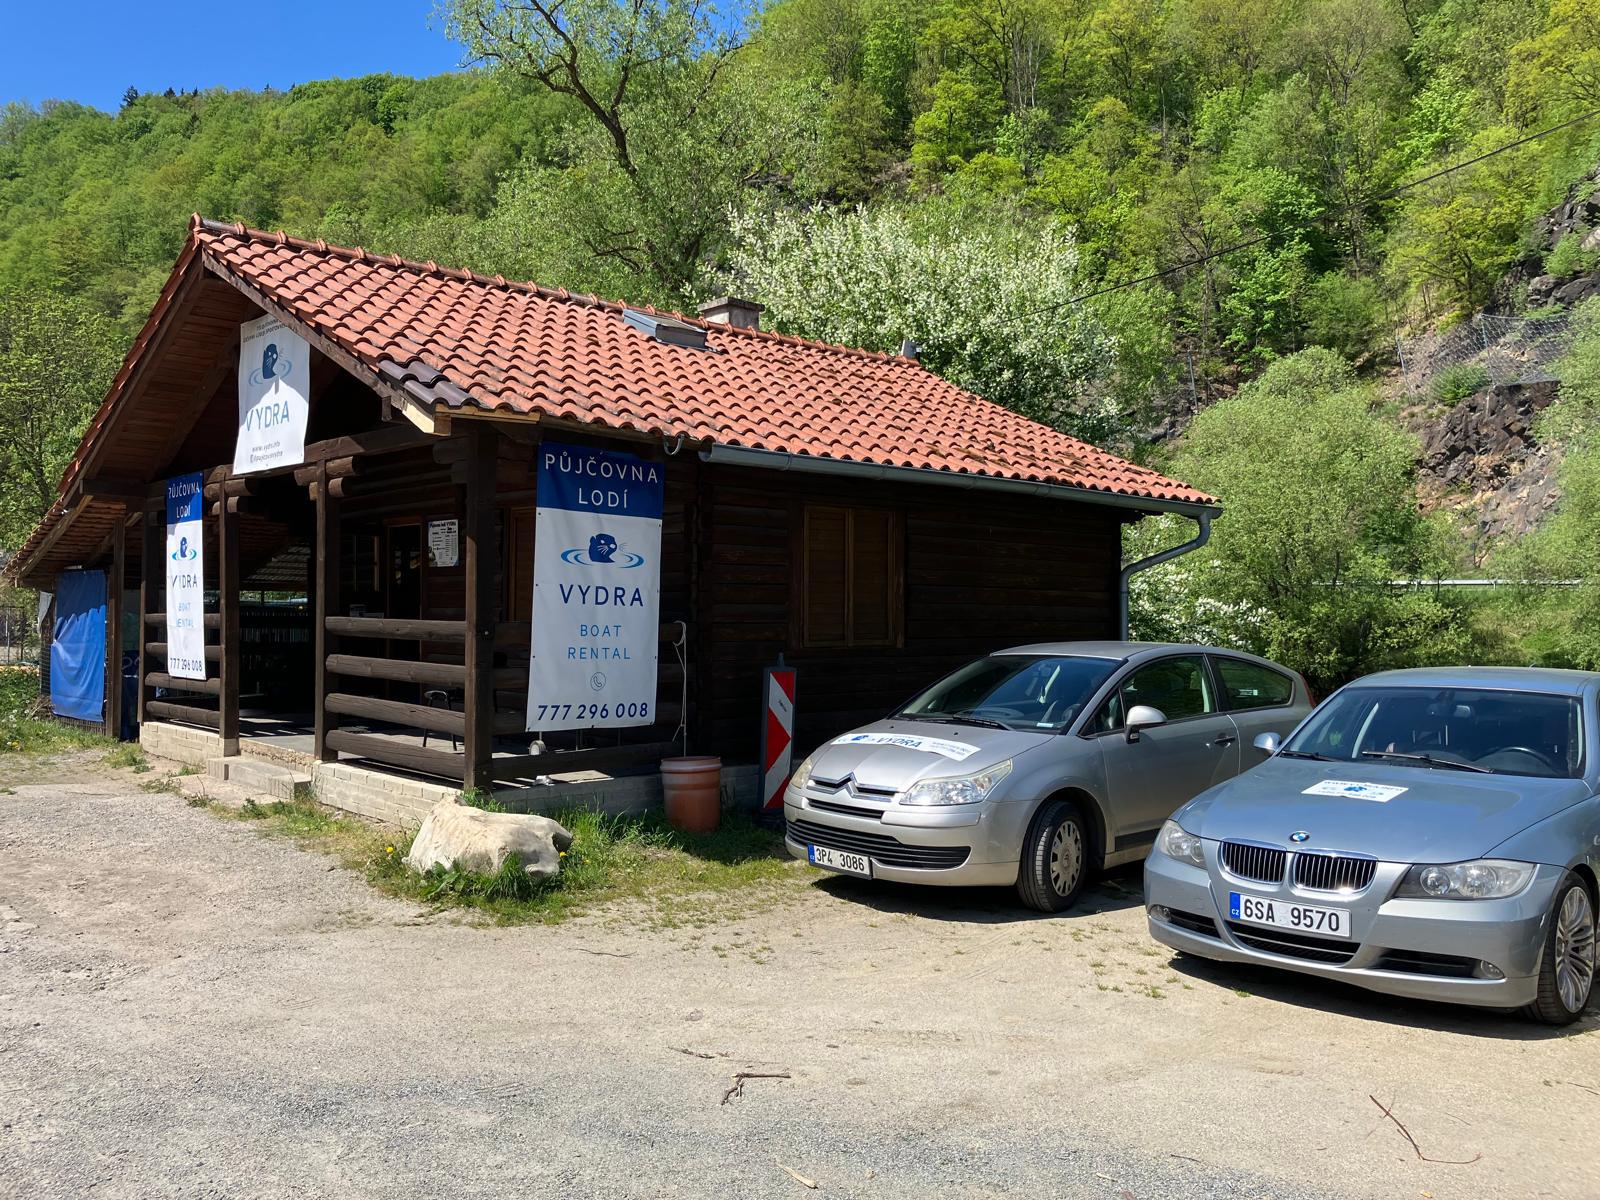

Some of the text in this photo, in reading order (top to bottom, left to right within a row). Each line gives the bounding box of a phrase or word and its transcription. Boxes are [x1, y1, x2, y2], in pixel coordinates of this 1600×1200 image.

[245, 400, 290, 432] VYDRA
[545, 451, 658, 483] PŮJČOVNA
[578, 487, 628, 509] LODÍ
[559, 584, 644, 607] VYDRA
[580, 624, 622, 637] BOAT
[567, 646, 631, 660] RENTAL
[170, 657, 181, 670] 777
[191, 659, 203, 672] 008
[538, 702, 648, 721] 777 296 008
[876, 736, 922, 749] VYDRA
[816, 848, 833, 865] 3P4
[839, 853, 865, 872] 3086
[1231, 898, 1340, 932] CZ 6SA 9570
